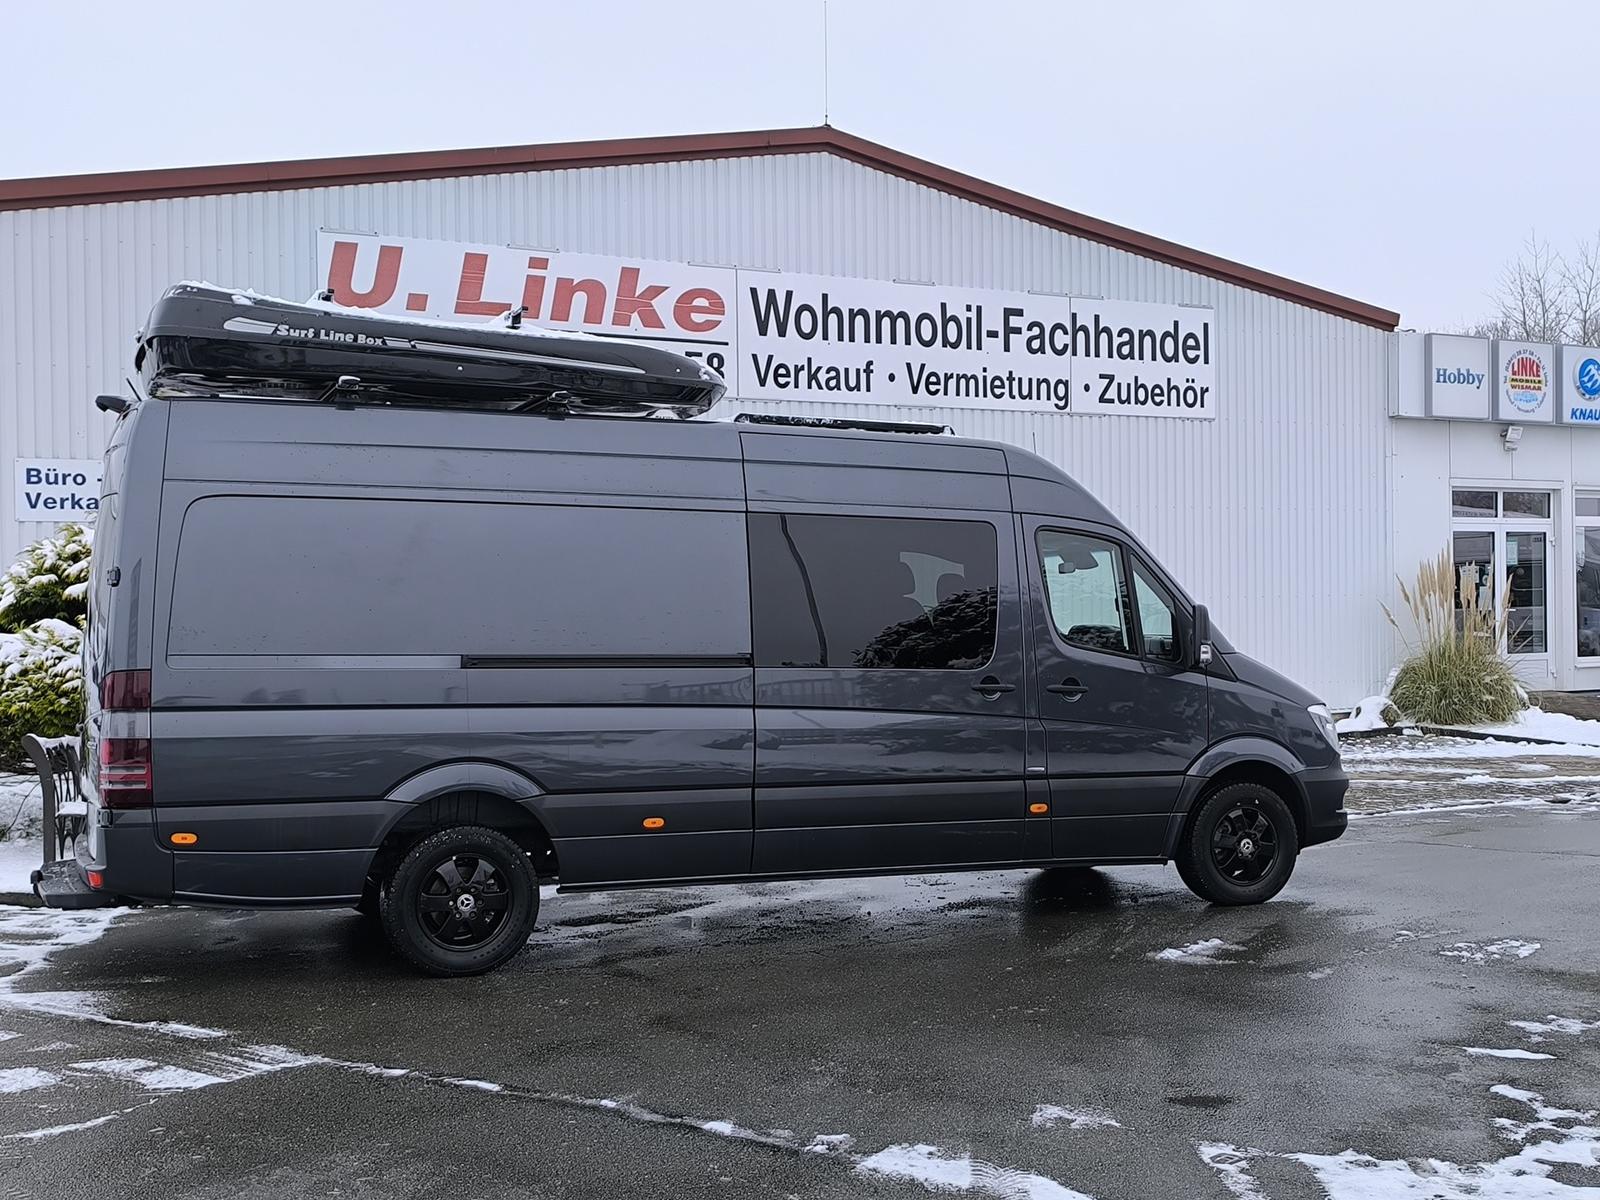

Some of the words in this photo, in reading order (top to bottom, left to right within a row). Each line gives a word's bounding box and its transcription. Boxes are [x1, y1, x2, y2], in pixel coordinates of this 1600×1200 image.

[327, 240, 430, 311] U.
[454, 251, 727, 333] Linke
[276, 324, 315, 338] Surf
[320, 329, 354, 342] Line
[357, 333, 384, 346] Box
[749, 286, 1210, 365] Wohnmobil-Fachhandel
[1435, 367, 1485, 389] Hobby
[1511, 356, 1541, 378] LINKE
[751, 353, 874, 393] Verkauf
[905, 361, 1070, 411] Vermietung
[1098, 373, 1210, 408] Zubehör
[1510, 377, 1542, 385] MOBILE
[1510, 384, 1542, 392] WISMAR
[25, 467, 87, 486] Büro
[24, 491, 99, 510] Verka
